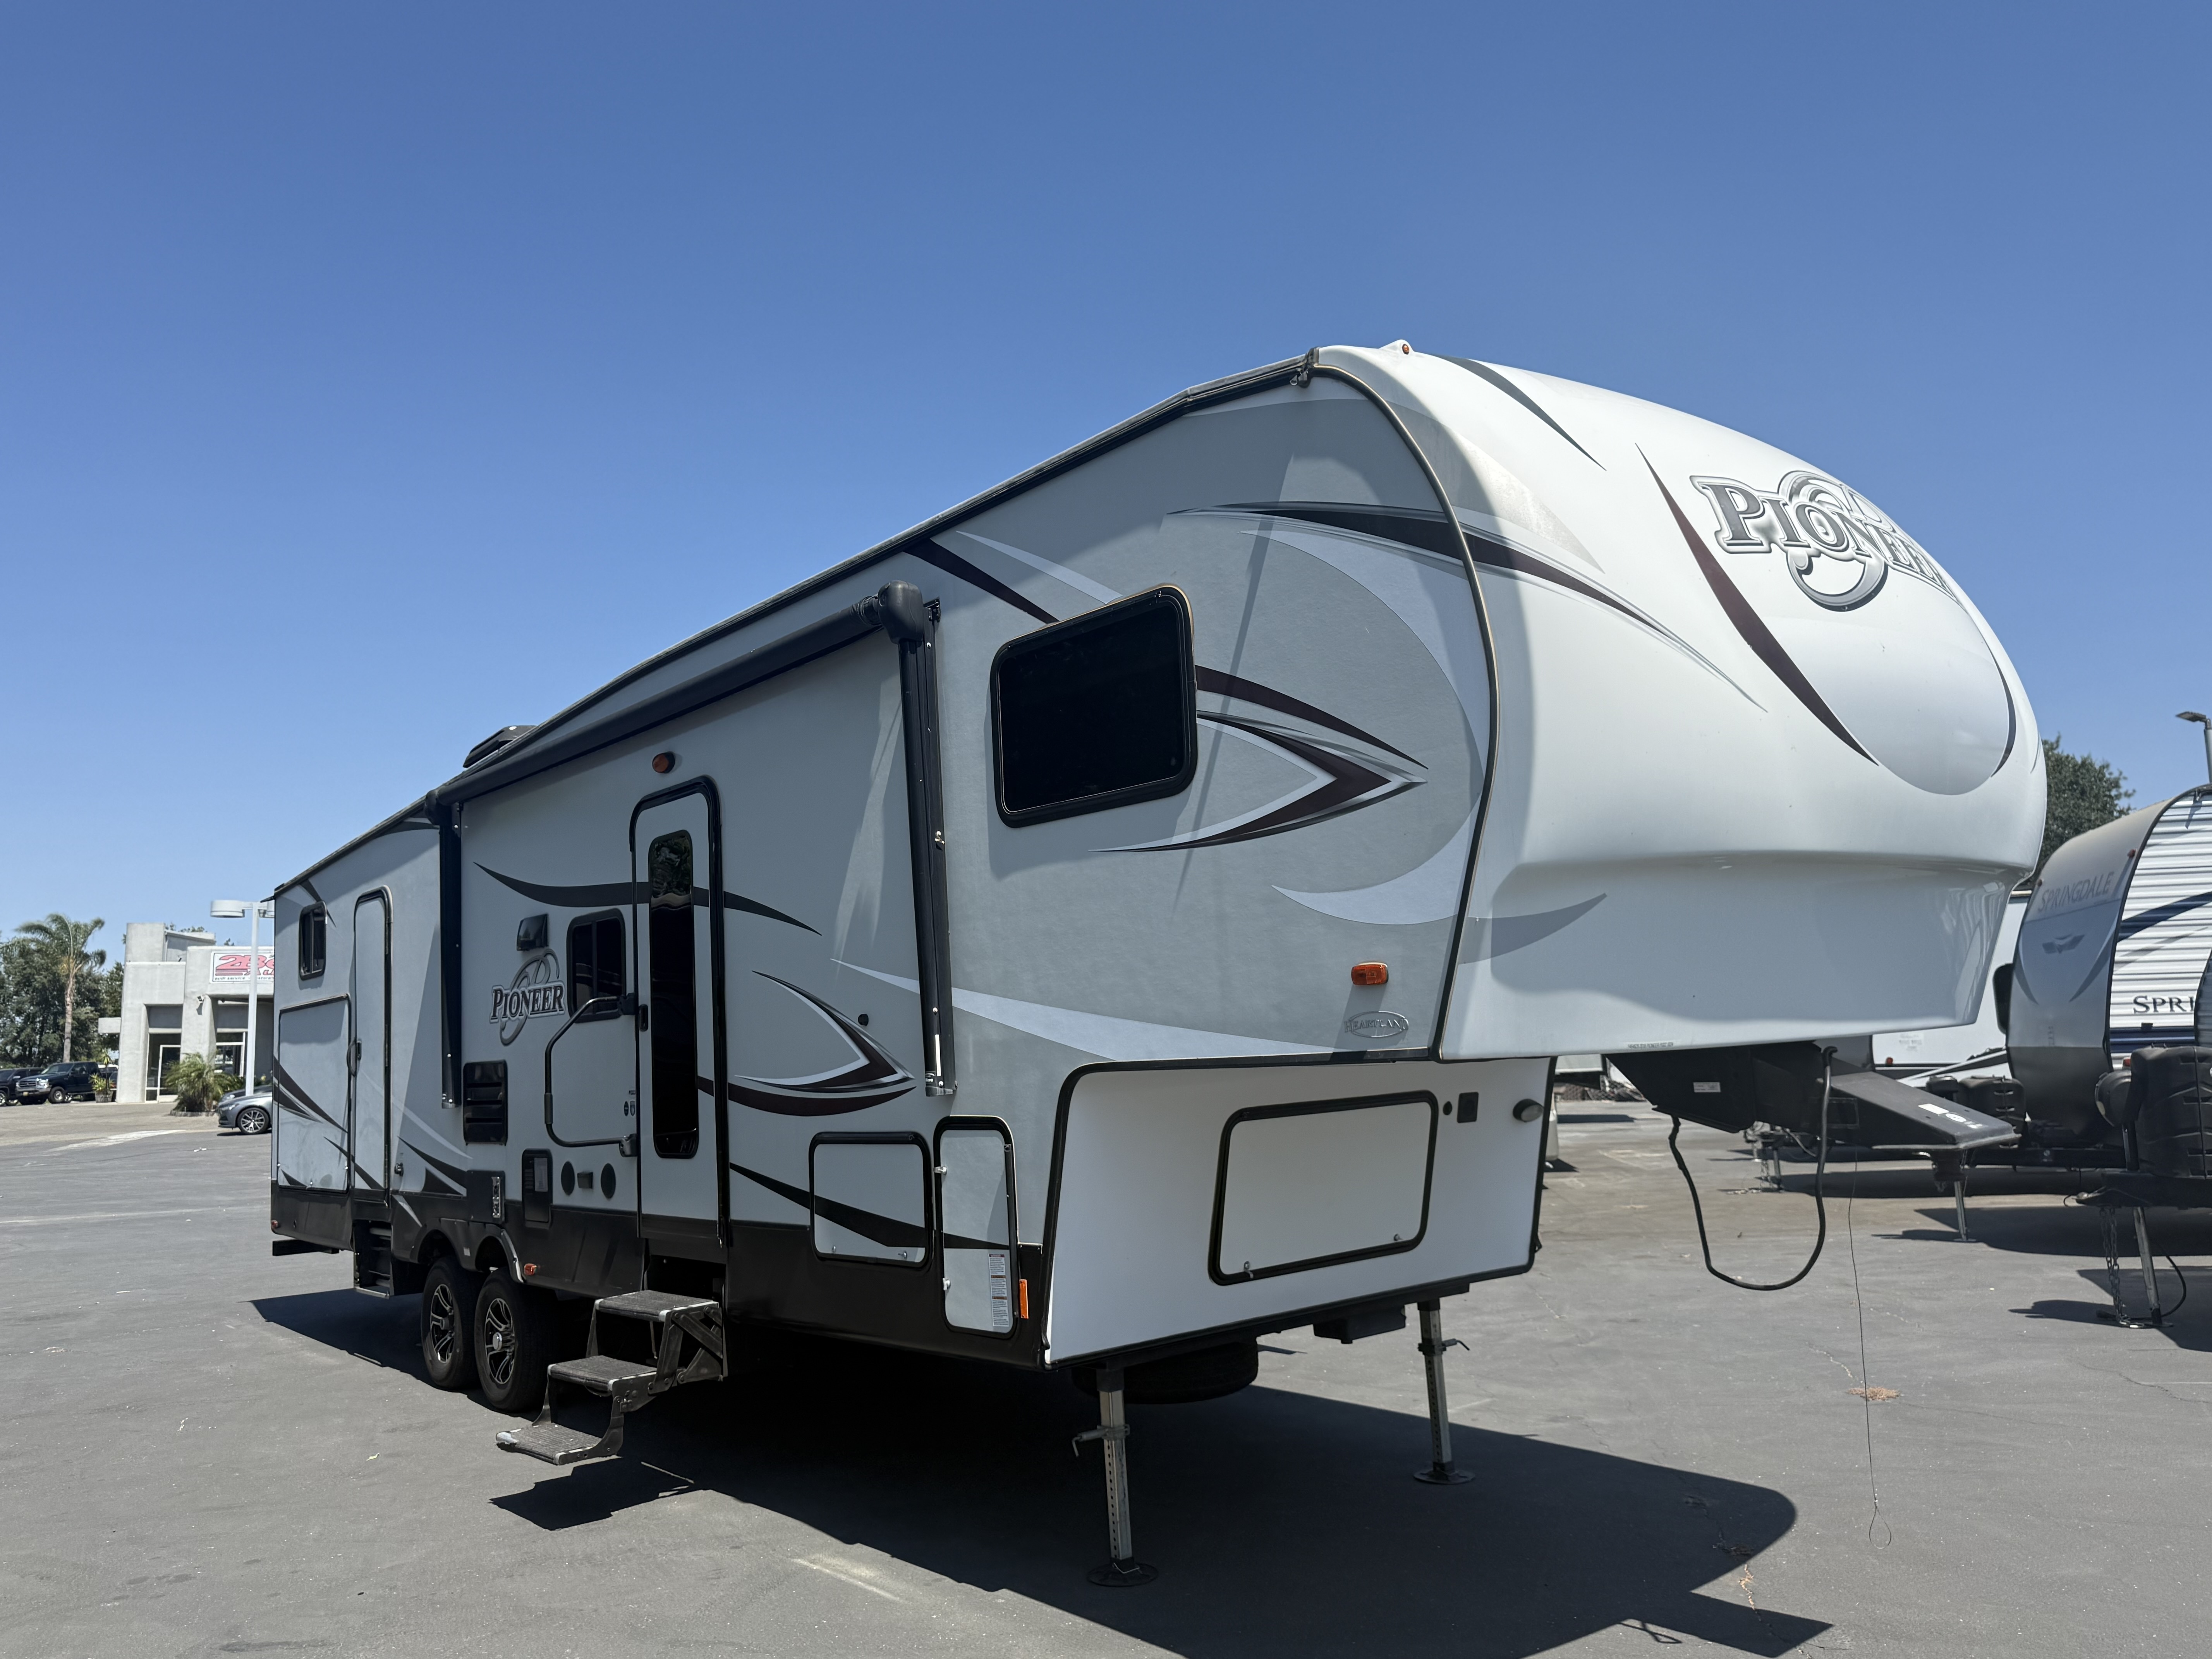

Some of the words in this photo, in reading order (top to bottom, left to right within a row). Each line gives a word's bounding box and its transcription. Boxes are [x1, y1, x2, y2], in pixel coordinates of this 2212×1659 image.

[2038, 872, 2114, 912] SPRINGDALE
[490, 985, 564, 1020] PIONEER
[1344, 1018, 1409, 1033] HEARTLAND
